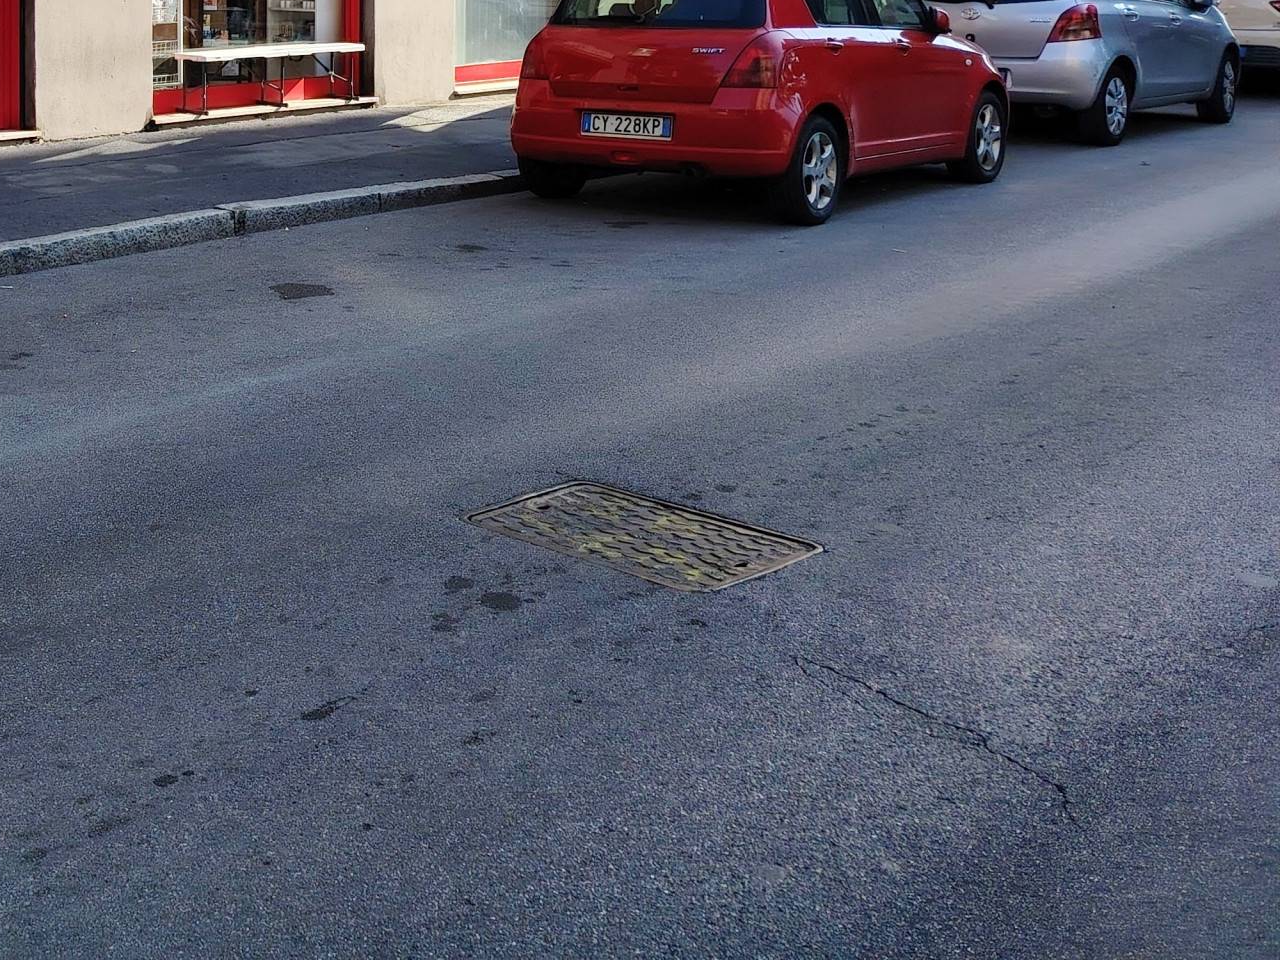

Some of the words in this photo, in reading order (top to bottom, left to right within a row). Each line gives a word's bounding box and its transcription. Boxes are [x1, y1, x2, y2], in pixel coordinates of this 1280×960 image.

[691, 47, 726, 55] SWIFT
[592, 115, 610, 132] CY
[614, 117, 661, 135] 228KP
